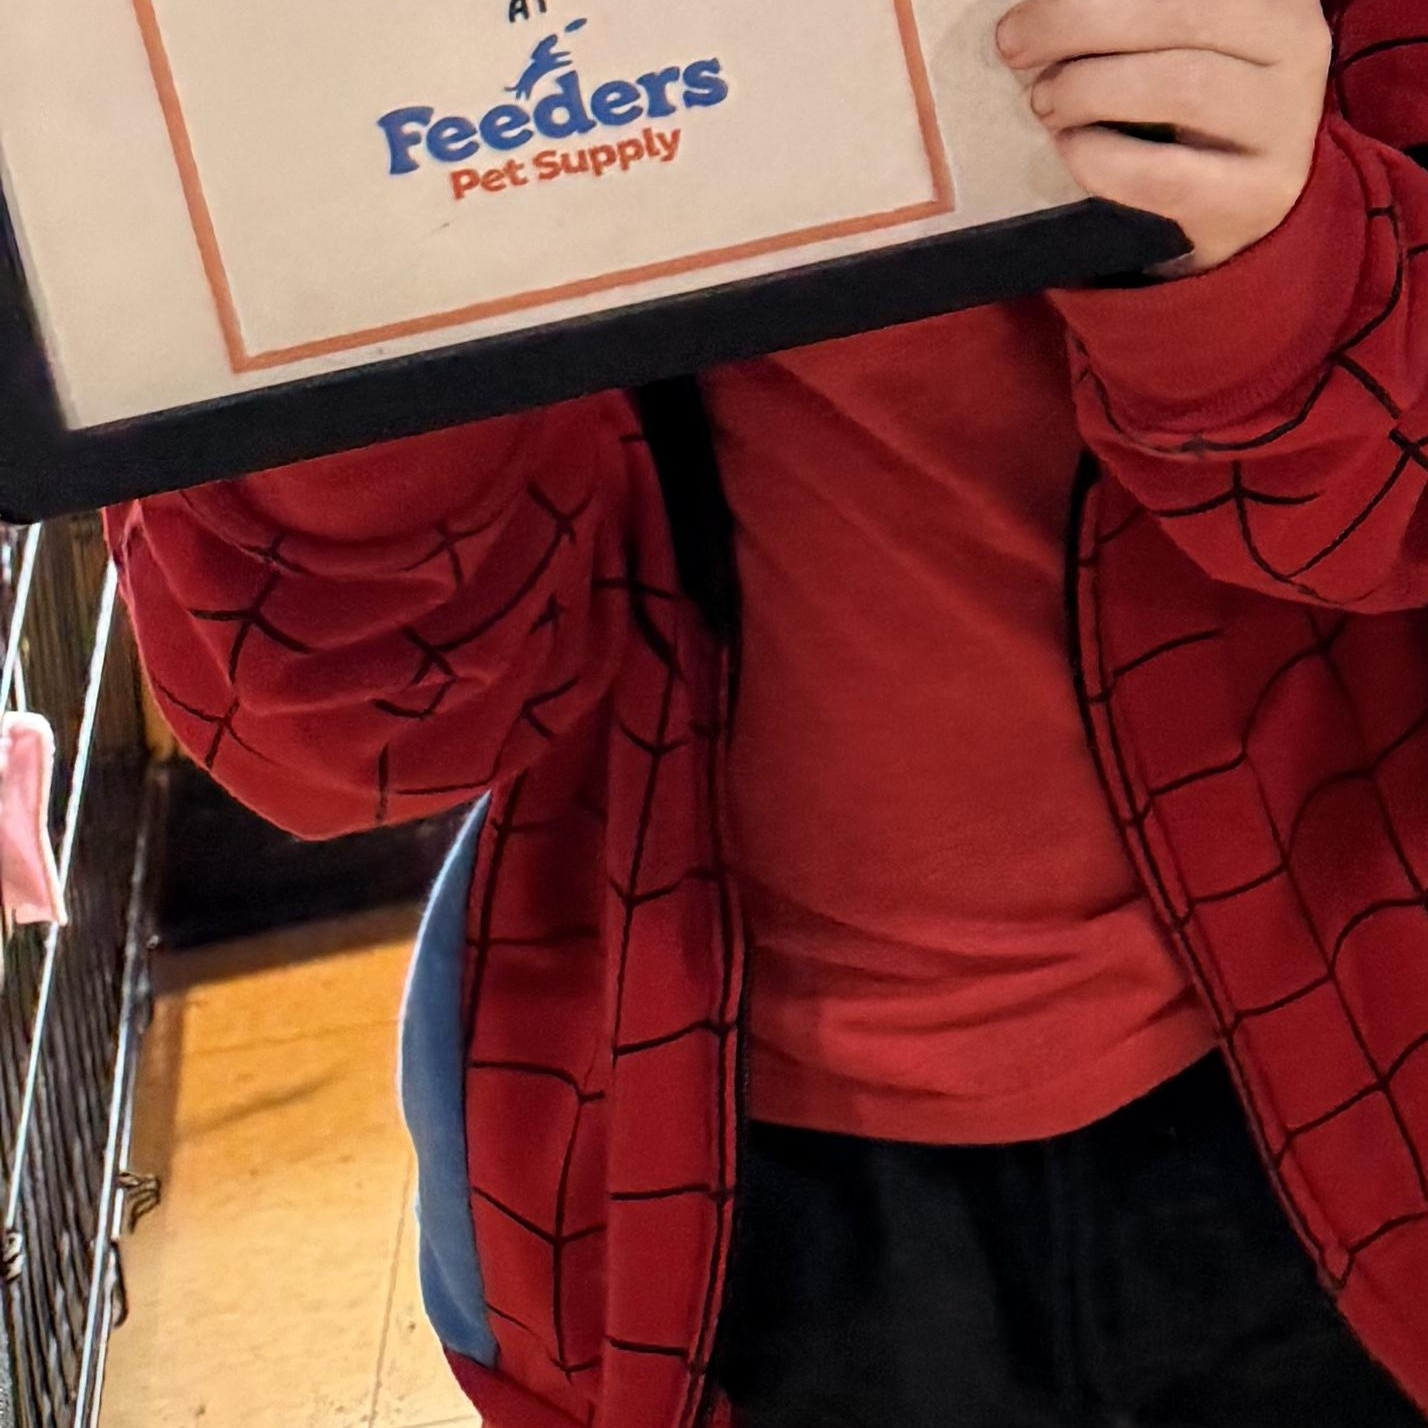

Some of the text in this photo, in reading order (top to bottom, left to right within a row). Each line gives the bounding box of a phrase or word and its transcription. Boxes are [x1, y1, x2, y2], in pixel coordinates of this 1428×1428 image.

[377, 58, 728, 175] Feeders
[450, 127, 681, 200] Pet Supply
